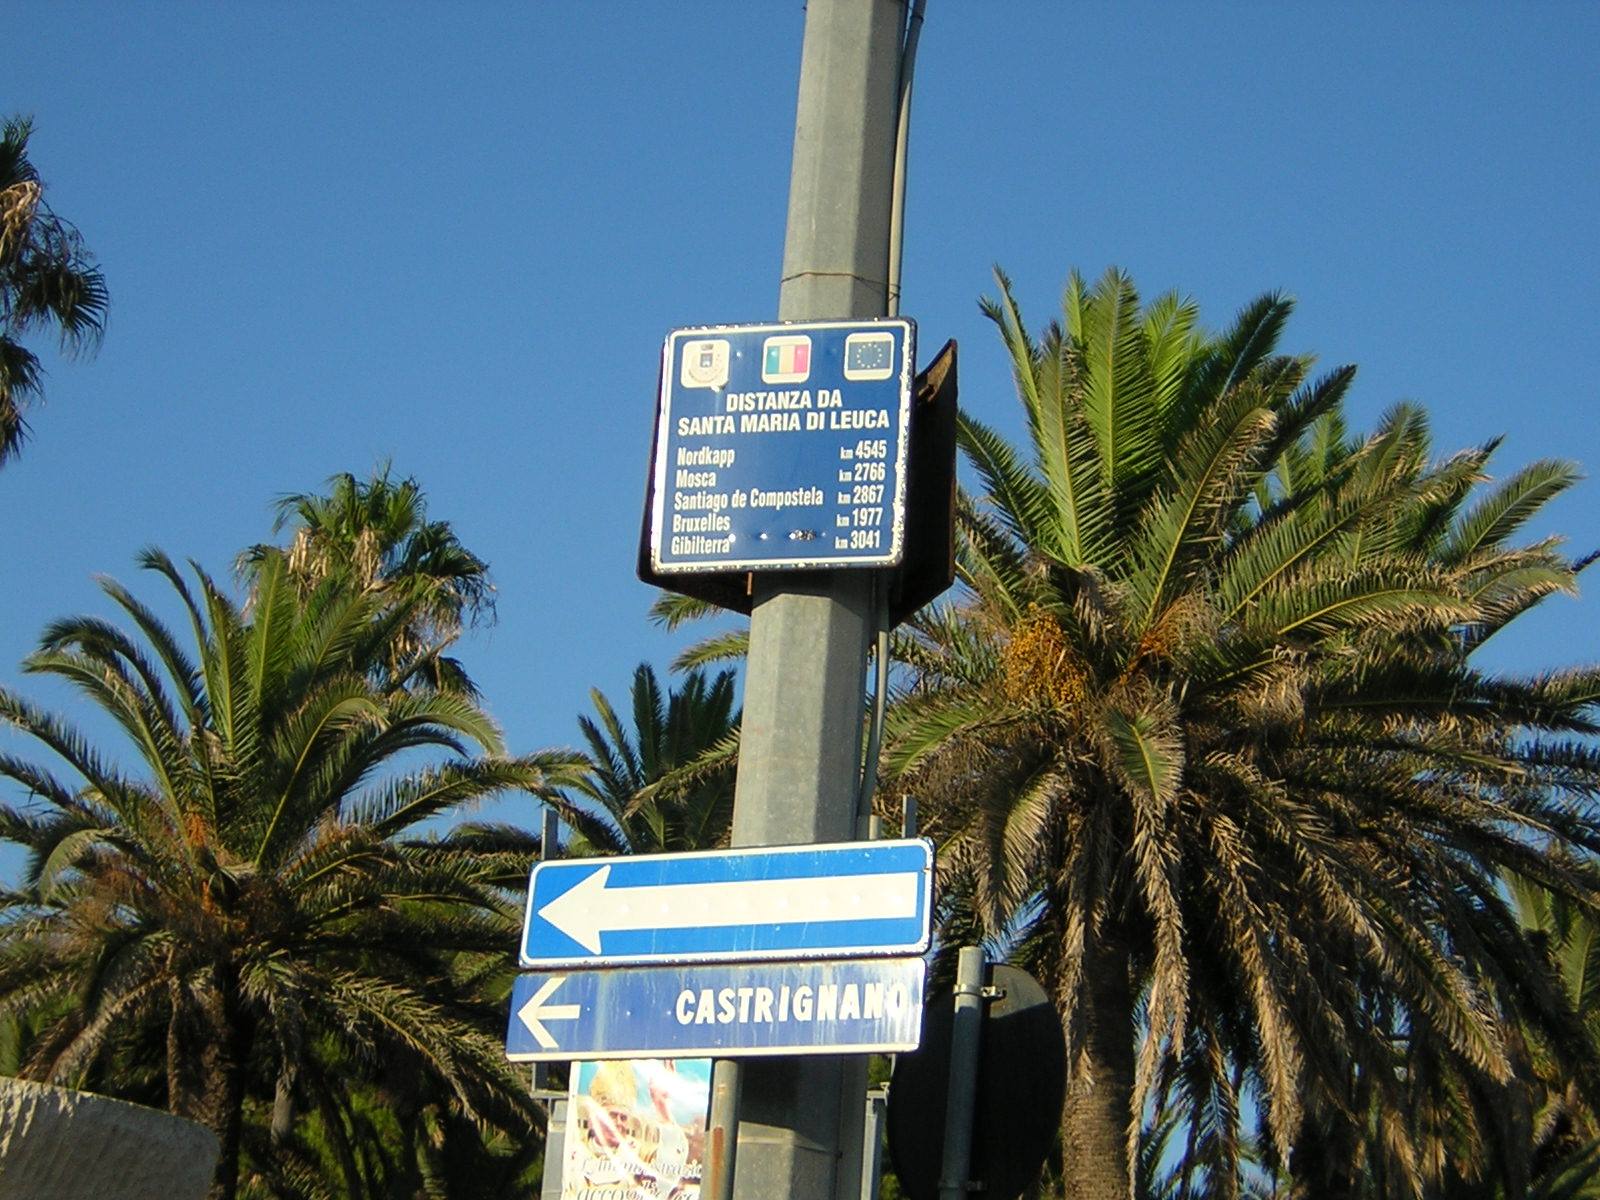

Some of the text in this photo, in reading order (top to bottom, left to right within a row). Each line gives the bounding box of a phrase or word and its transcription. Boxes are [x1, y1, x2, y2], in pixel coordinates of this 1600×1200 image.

[726, 389, 843, 412] DISTANZA DA
[678, 409, 890, 436] SANTA MARIA DI LEUCA
[677, 439, 887, 468] Nordkapp km 4545
[675, 462, 885, 489] Mosca km 2766
[674, 485, 885, 512] Santiago de Compostela km 2867
[672, 507, 883, 533] Bruxelles km 1977
[671, 530, 880, 555] Gibilterra km 3041
[676, 982, 909, 1025] CASTRIGNANO
